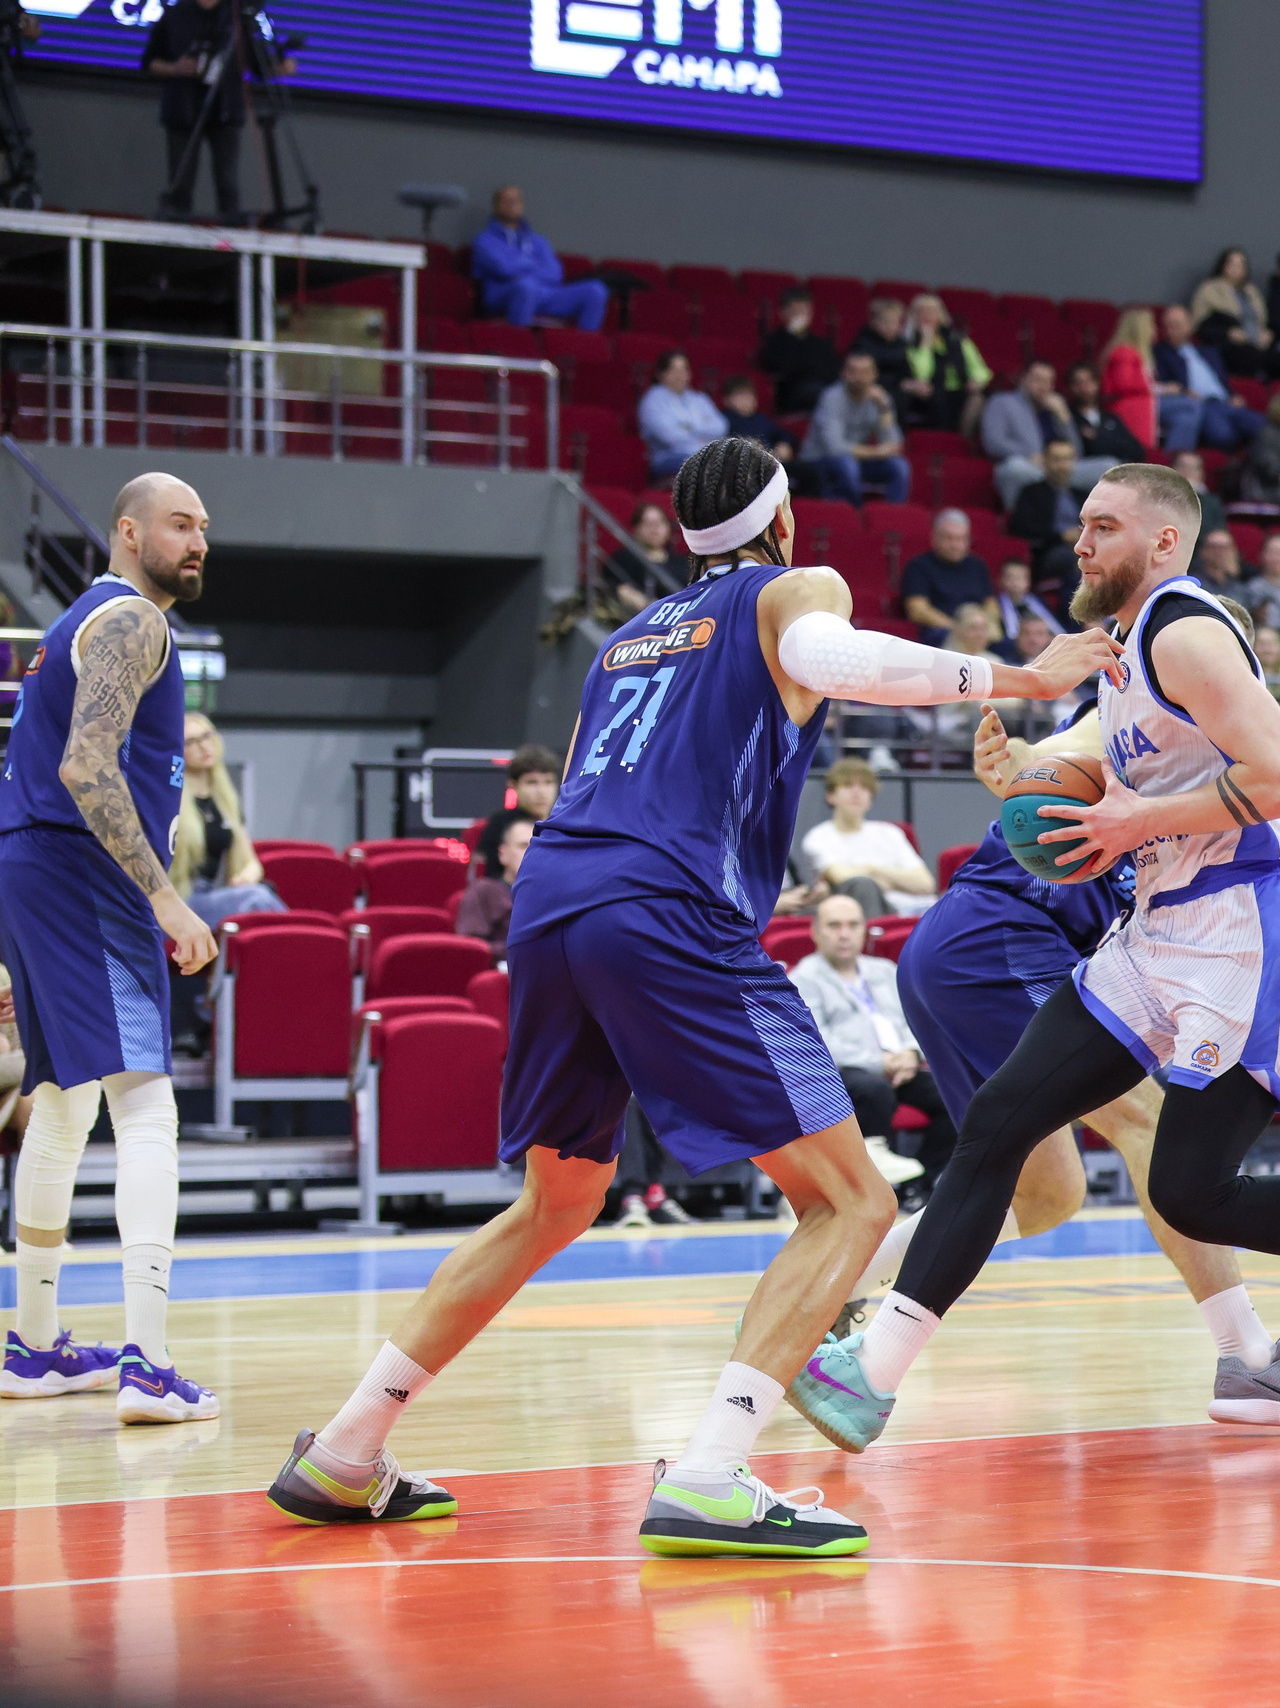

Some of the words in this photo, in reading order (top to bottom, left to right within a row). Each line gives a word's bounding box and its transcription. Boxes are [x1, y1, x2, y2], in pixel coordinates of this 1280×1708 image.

[632, 49, 783, 98] САМАРА
[612, 627, 691, 665] WINLNE
[579, 666, 677, 778] 21
[384, 1387, 407, 1403] adidas
[726, 1396, 757, 1415] adidas
